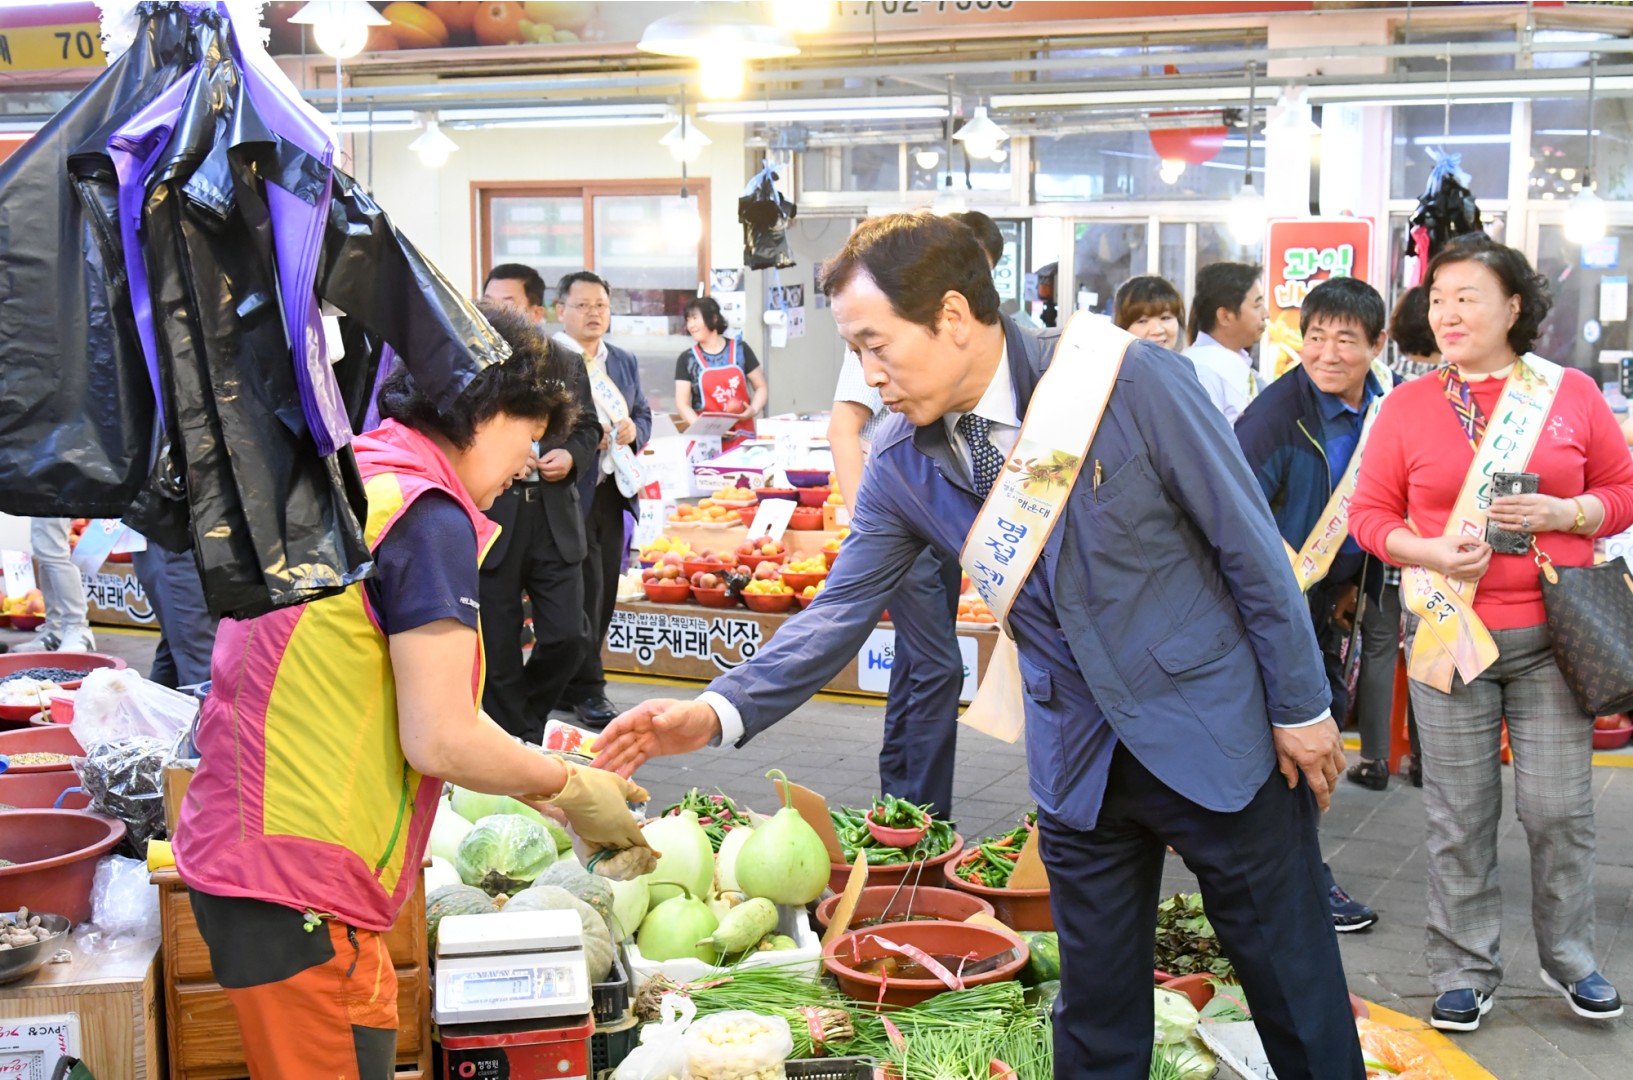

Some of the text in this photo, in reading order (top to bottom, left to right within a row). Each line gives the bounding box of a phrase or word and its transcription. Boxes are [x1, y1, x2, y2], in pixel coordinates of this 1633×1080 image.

[54, 31, 101, 59] 70
[1286, 247, 1351, 279] 과일
[984, 516, 1028, 566] 명절
[639, 614, 667, 627] 밥상을
[671, 616, 707, 630] 책임지는
[477, 1059, 499, 1070] 청정원
